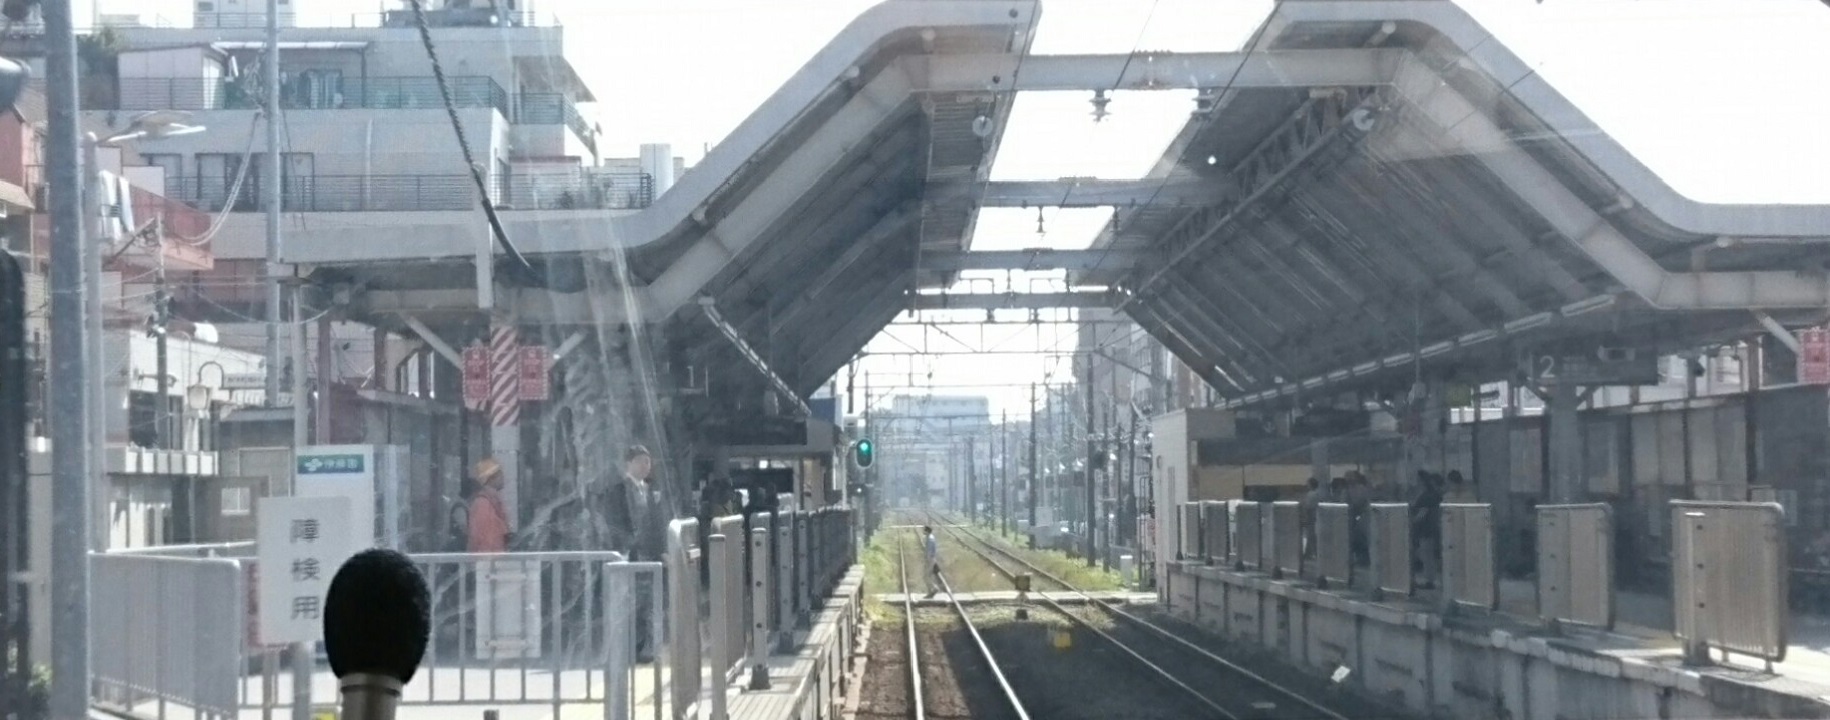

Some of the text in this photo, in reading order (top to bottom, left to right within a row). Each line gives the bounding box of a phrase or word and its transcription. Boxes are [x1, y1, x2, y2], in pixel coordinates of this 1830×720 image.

[1540, 355, 1555, 378] 2
[290, 518, 320, 620] 障検用
